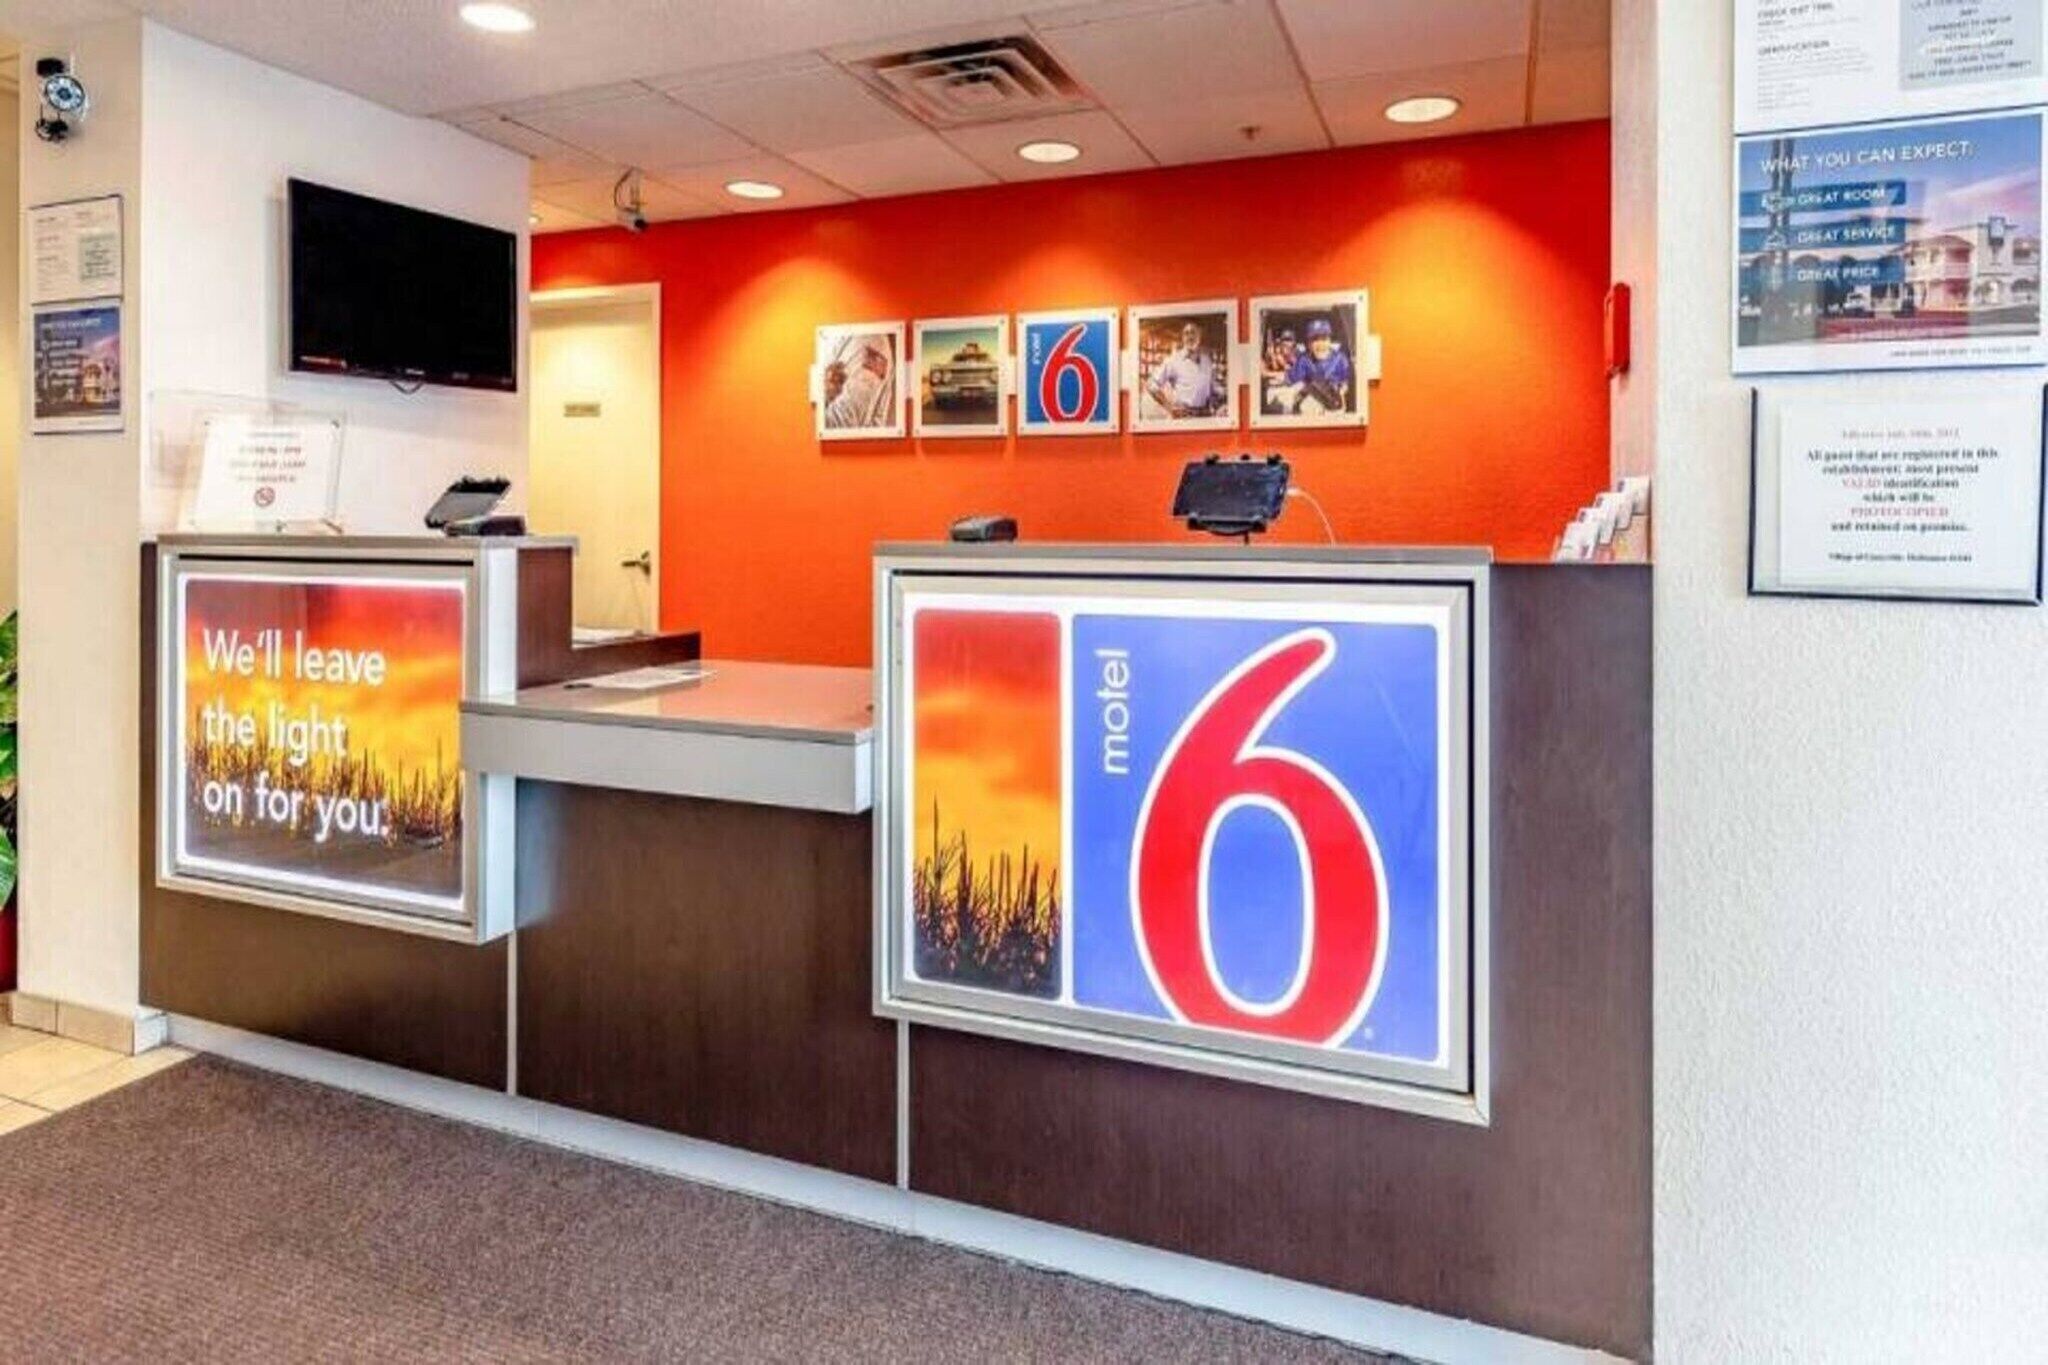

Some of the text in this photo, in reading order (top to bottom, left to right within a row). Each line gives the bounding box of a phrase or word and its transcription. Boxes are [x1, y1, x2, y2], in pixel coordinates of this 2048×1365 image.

[1761, 157, 1809, 174] WHAT
[1817, 152, 1850, 168] YOU
[1857, 148, 1895, 164] CAN
[1798, 187, 1887, 205] GREAT ROOM
[1798, 224, 1896, 244] GREAT SERVICE
[1797, 265, 1881, 282] GREAT PRICE
[1040, 322, 1099, 424] 6
[1808, 450, 1822, 461] All
[1856, 450, 1879, 461] that
[1882, 452, 1899, 461] are
[1902, 450, 1959, 462] registered
[1962, 449, 1974, 460] in
[1977, 448, 1998, 459] this
[1936, 464, 1979, 475] present
[1842, 478, 1959, 489] VALID identification
[1863, 492, 1936, 502] which will be
[1850, 506, 1950, 518] PHOTOCOPIED
[1831, 521, 1851, 531] and
[1903, 522, 1918, 531] on
[203, 628, 387, 685] We'll leave
[203, 695, 347, 767] the light
[203, 780, 242, 816] on
[255, 771, 305, 823] for
[1095, 626, 1390, 1049] motel 6
